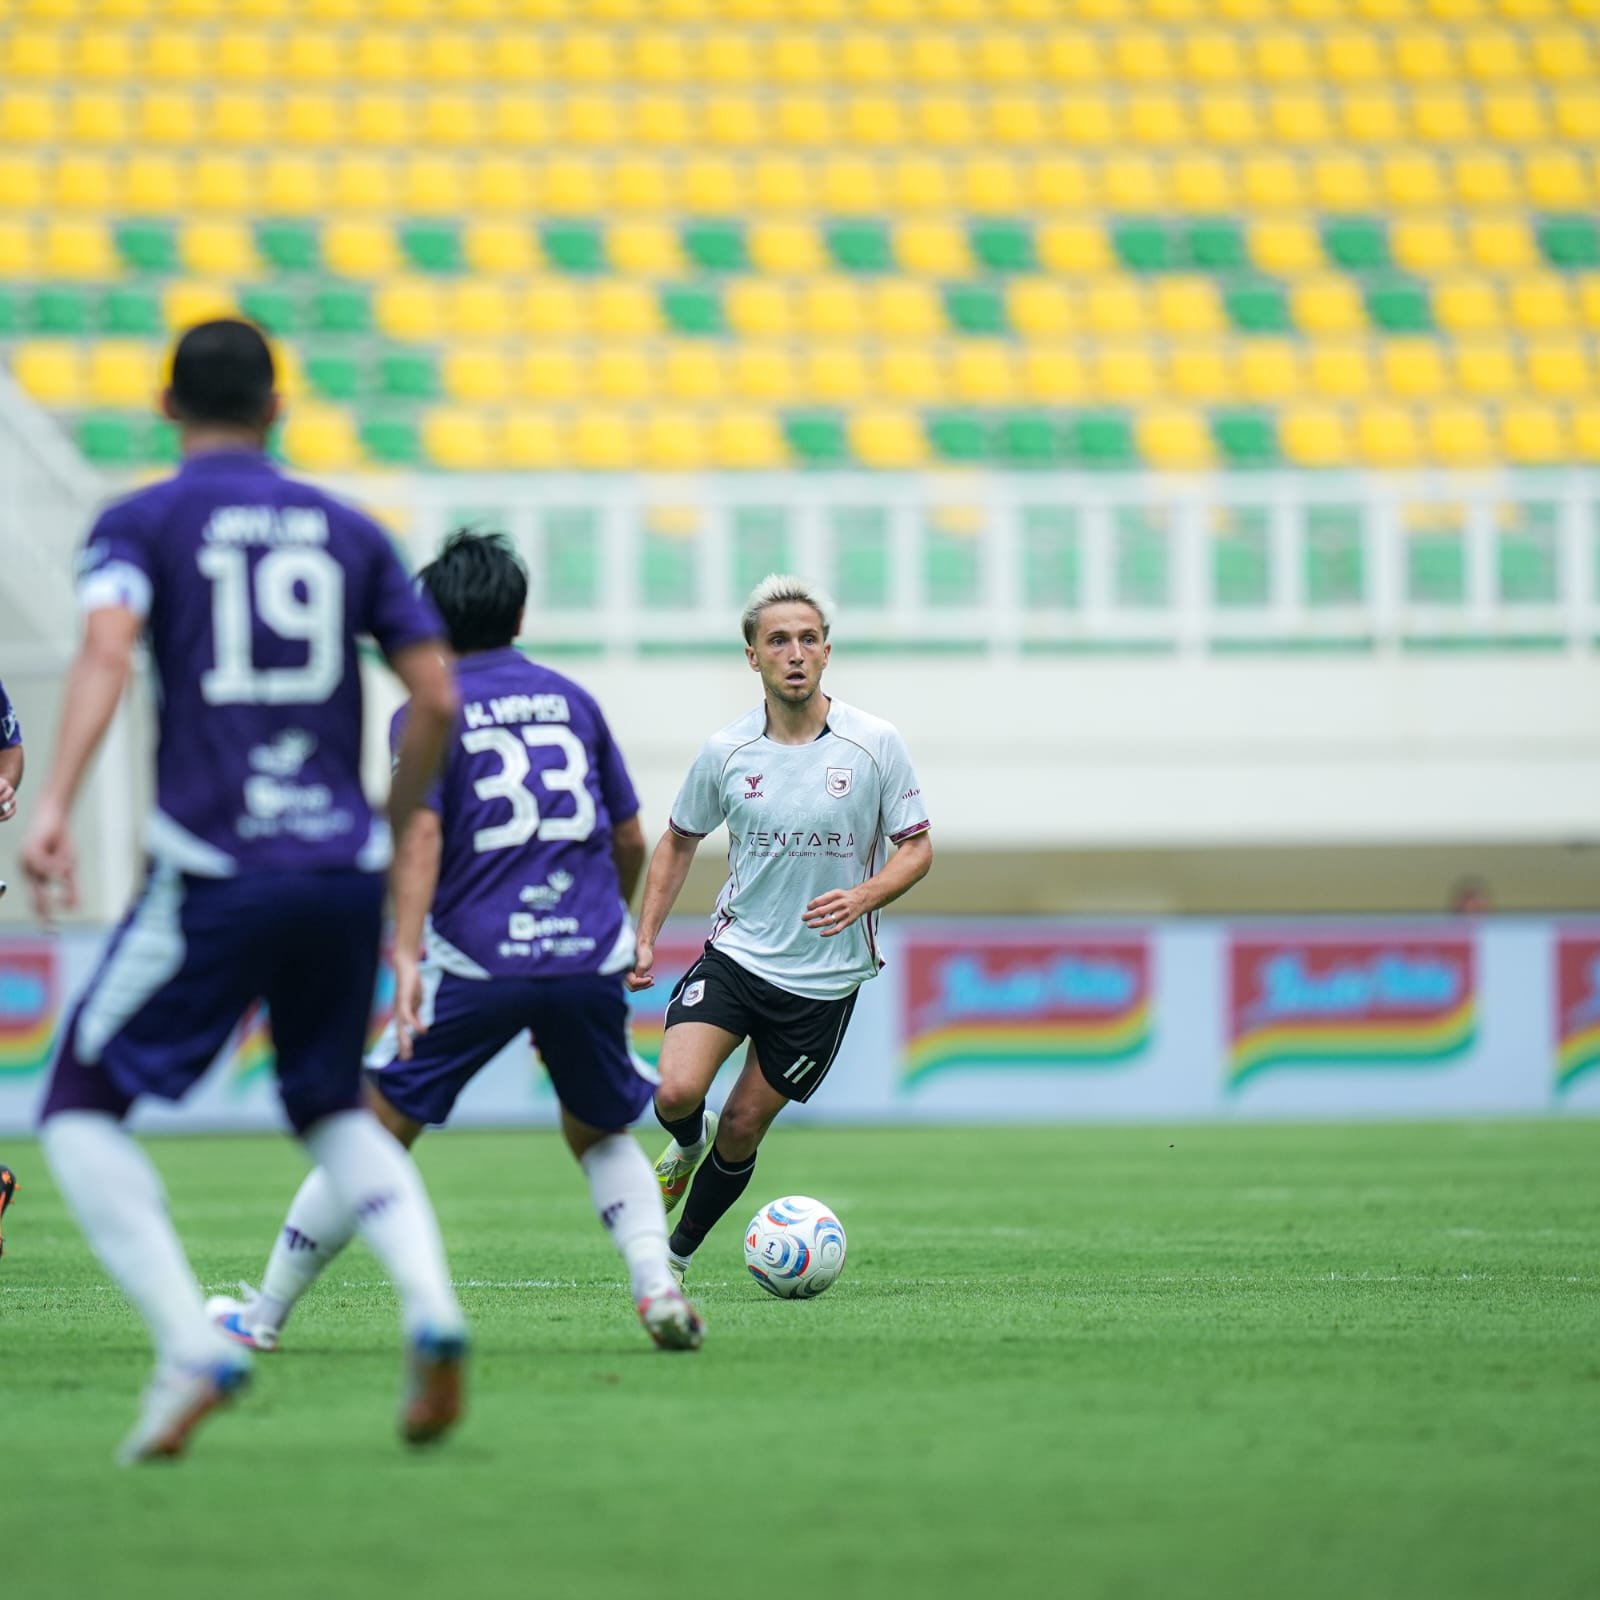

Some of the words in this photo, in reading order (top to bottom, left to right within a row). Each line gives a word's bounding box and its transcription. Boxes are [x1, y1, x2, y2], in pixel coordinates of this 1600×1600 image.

[196, 544, 345, 706] 19
[461, 723, 597, 852] 33
[744, 791, 764, 799] DRX
[782, 1054, 816, 1084] 11
